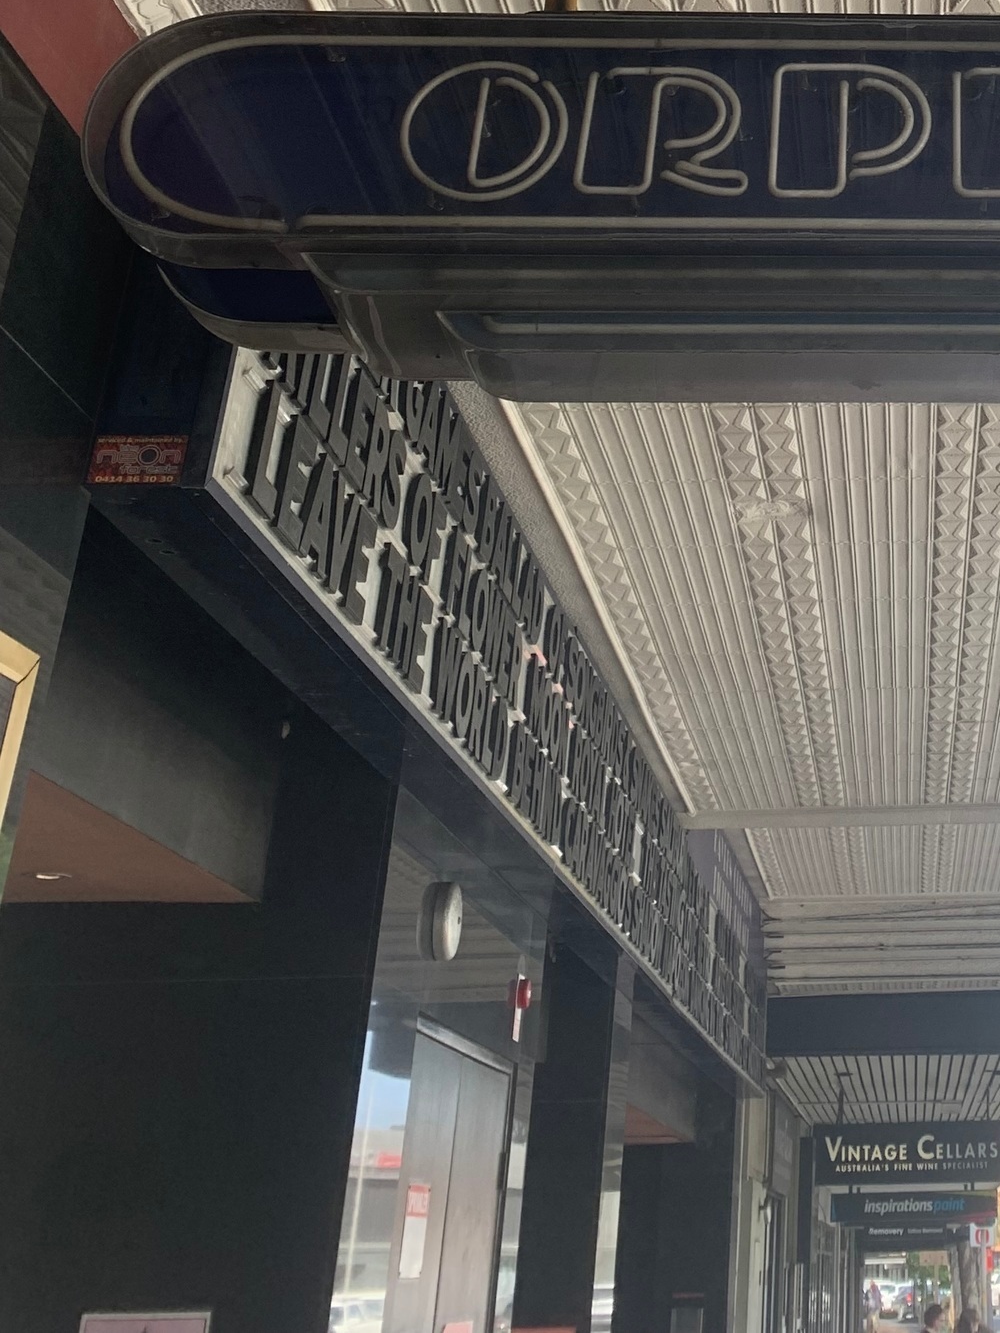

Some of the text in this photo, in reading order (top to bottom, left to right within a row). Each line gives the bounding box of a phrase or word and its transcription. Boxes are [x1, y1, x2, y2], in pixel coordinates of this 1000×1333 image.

[95, 475, 123, 483] 0414
[142, 475, 157, 483] 30
[404, 379, 483, 536] GAMES
[480, 488, 544, 645] BALLAD
[549, 610, 569, 681] OF
[563, 633, 624, 785] SONGBIRDS
[251, 378, 378, 625] LEAVE
[380, 542, 434, 694] THE
[436, 616, 508, 780] WORLD
[512, 721, 562, 849] BEHIND
[410, 472, 449, 586] OF
[449, 524, 522, 710] FLOWER
[528, 662, 570, 777] MOON
[570, 722, 609, 831] ROYAL
[607, 781, 637, 874] HOTEL
[642, 829, 660, 902] THE
[825, 1134, 998, 1162] VINTAGE CELLARS
[835, 1161, 988, 1173] AUSTRALIA'S FINE WINE SPECIALIST
[864, 1197, 965, 1216] inspirations paint
[868, 1227, 904, 1237] Removery
